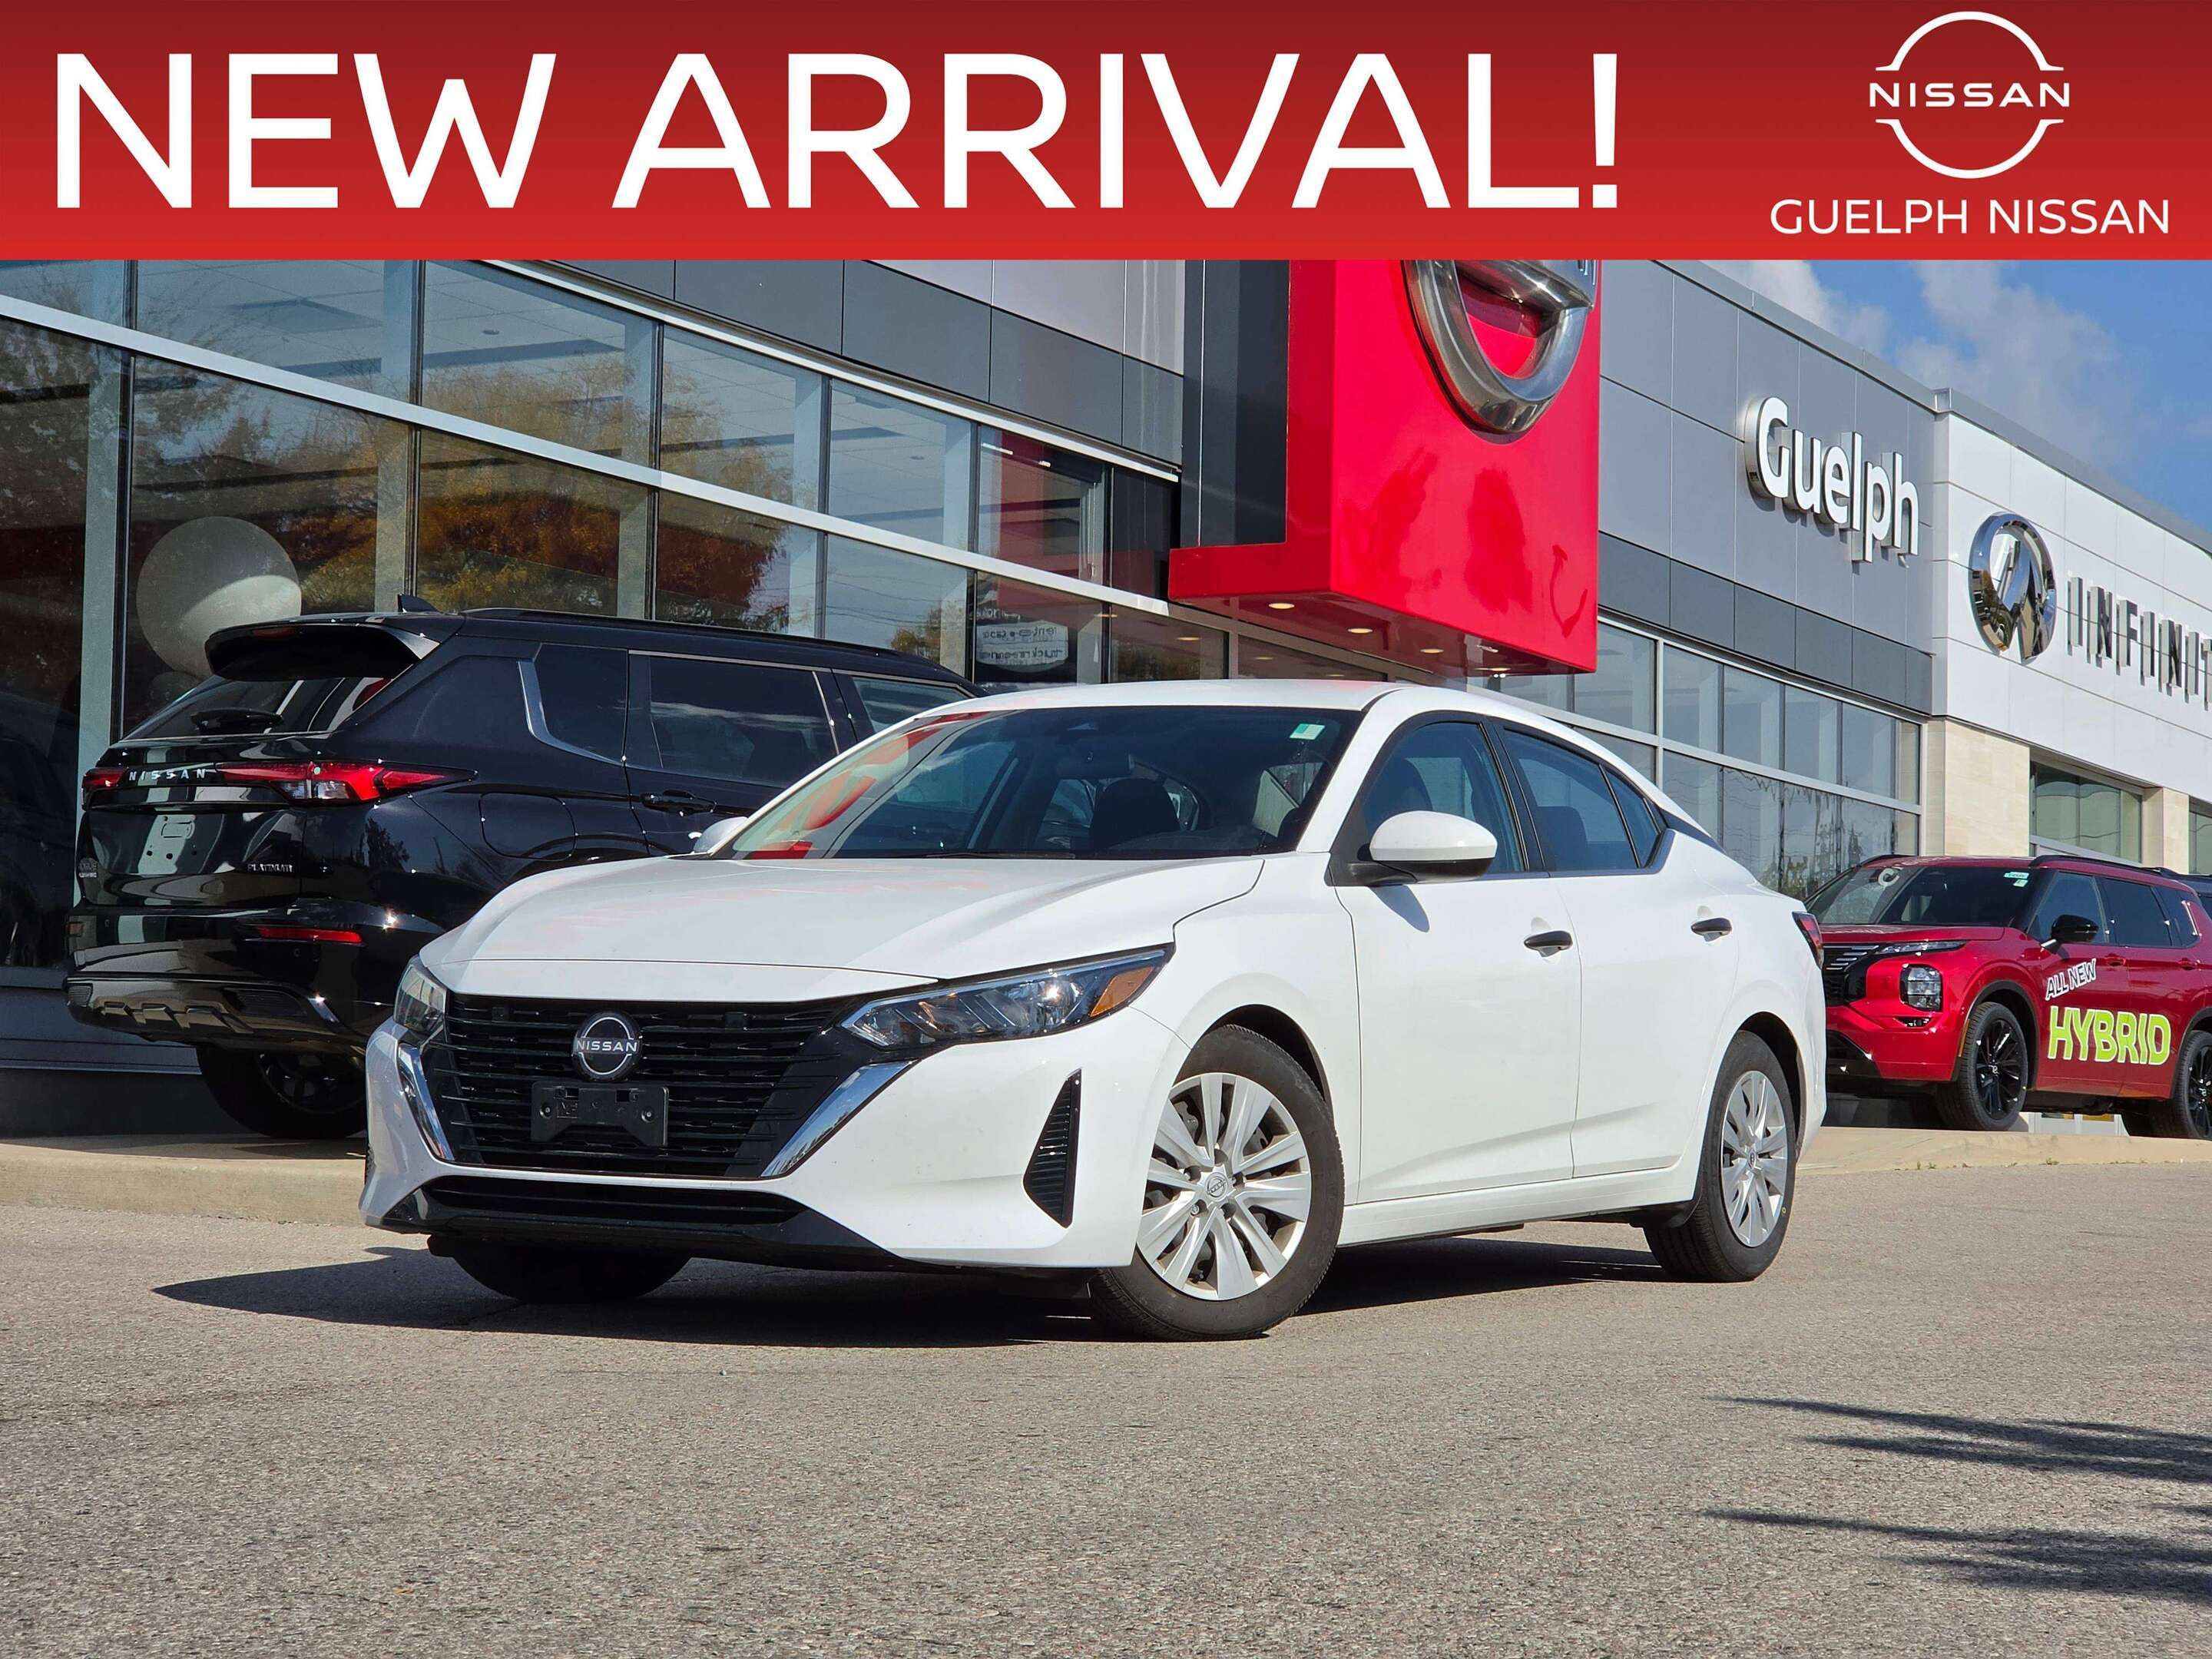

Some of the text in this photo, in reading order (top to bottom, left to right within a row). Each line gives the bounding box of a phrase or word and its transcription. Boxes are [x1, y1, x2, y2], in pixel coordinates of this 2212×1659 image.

[1750, 396, 1919, 563] Guelph
[128, 768, 207, 781] NISSAN
[2045, 958, 2097, 1001] ALL NEW
[575, 1040, 638, 1053] NISSAN
[2047, 1005, 2171, 1066] HYBRID
